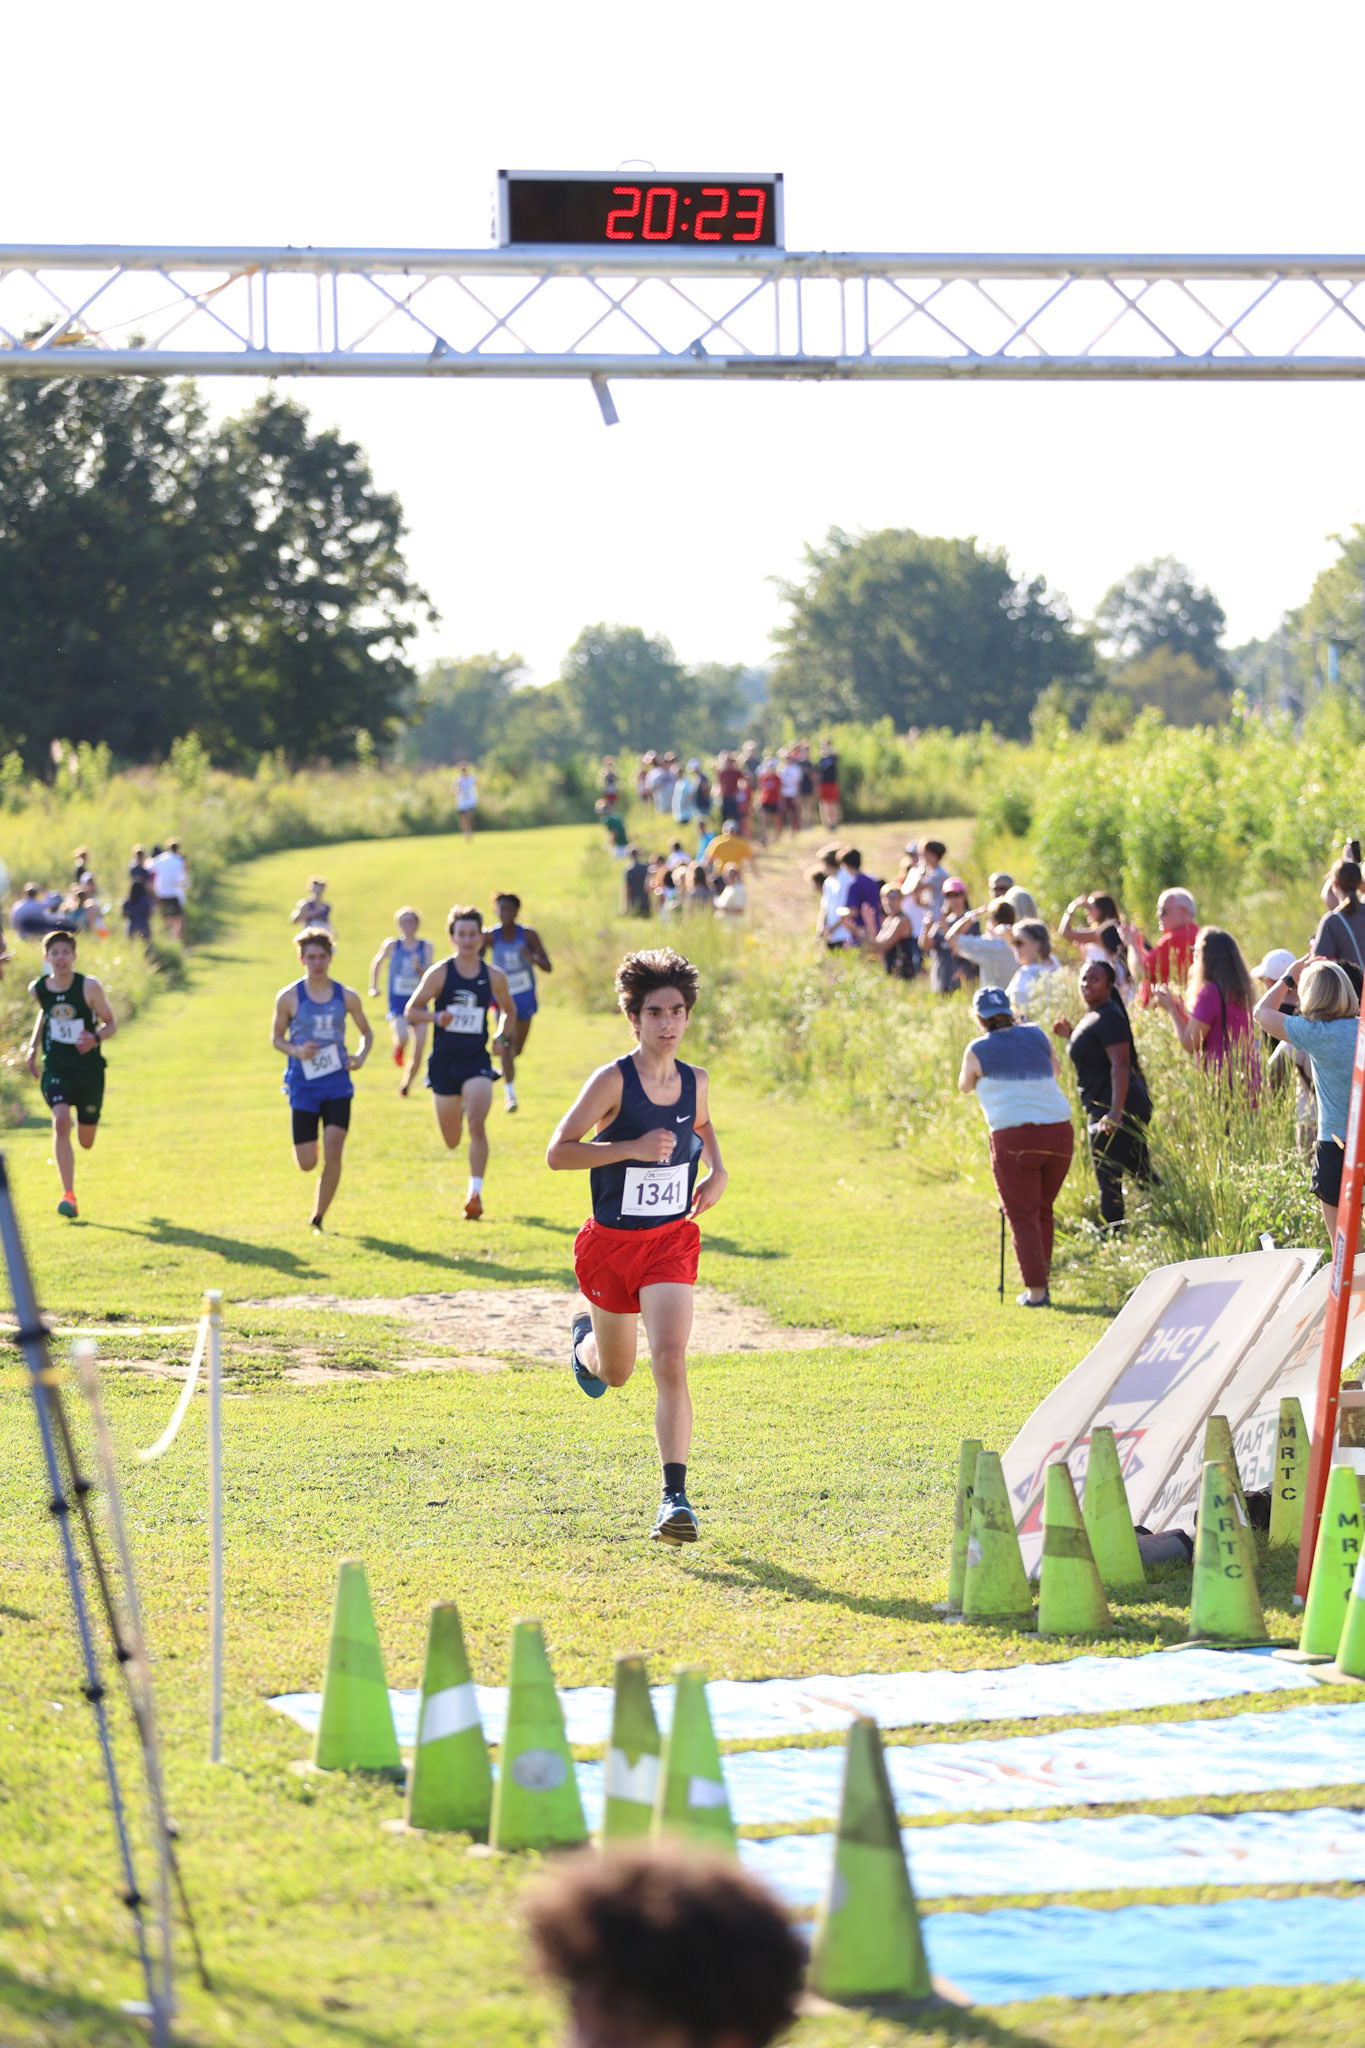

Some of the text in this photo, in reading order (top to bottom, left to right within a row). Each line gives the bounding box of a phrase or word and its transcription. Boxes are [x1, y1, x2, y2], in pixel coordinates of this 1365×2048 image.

[605, 186, 767, 240] 20:23
[60, 1026, 72, 1039] 51
[311, 1055, 333, 1072] 501
[636, 1180, 681, 1206] 1341
[1278, 1425, 1298, 1501] MRTC
[1213, 1494, 1243, 1579] MRTC
